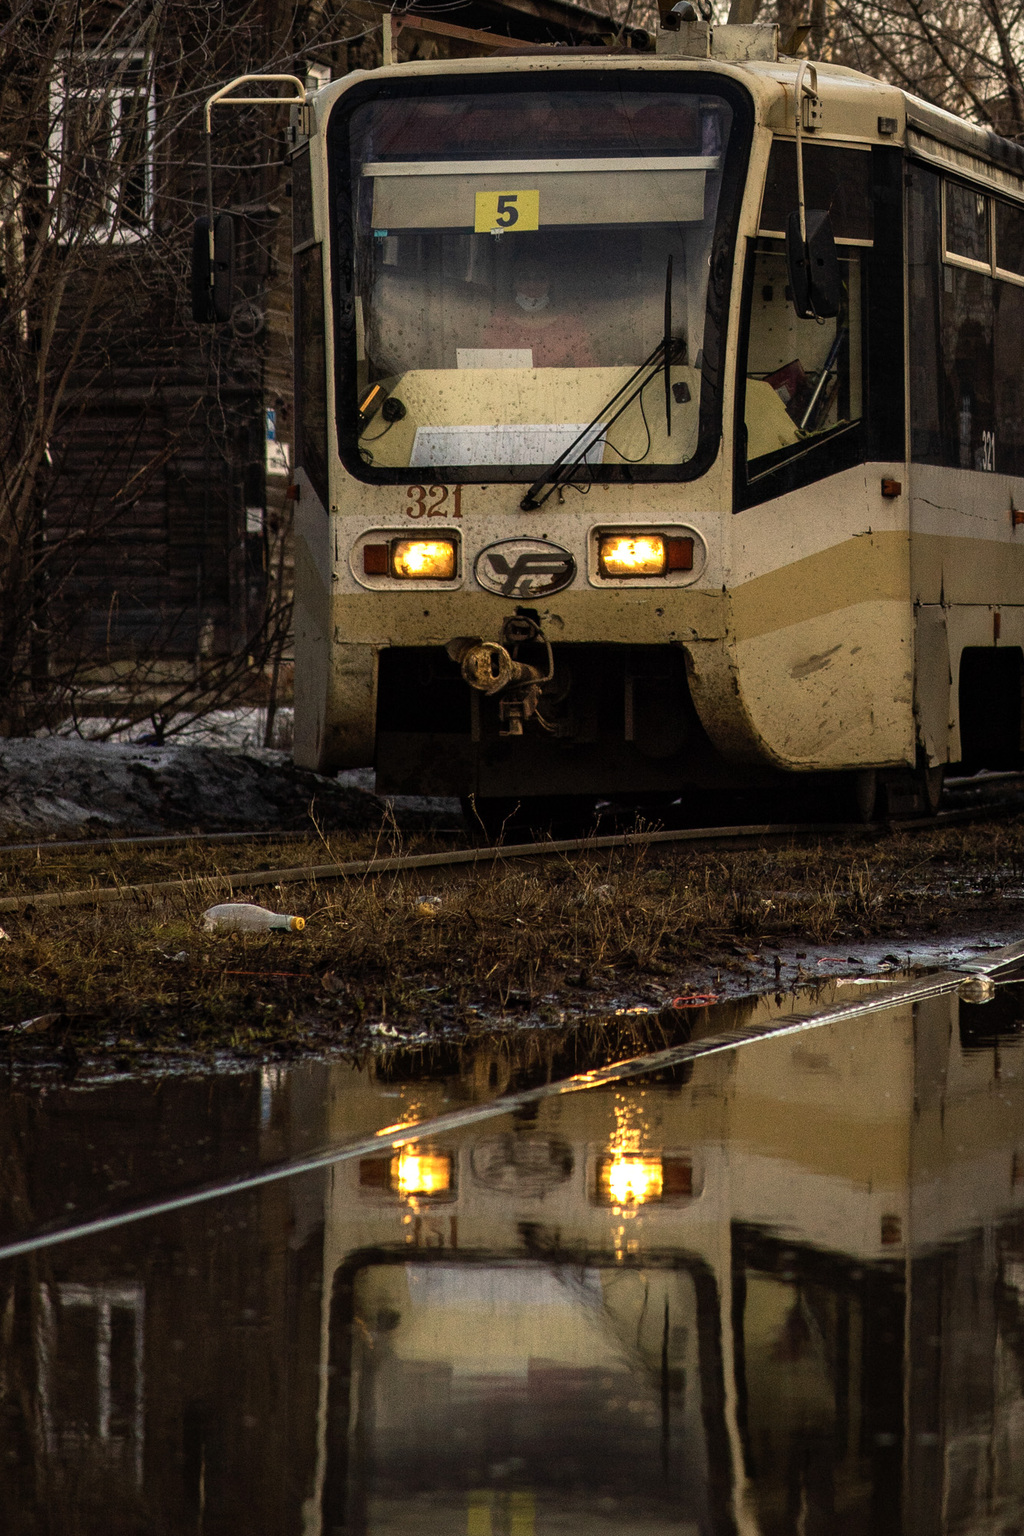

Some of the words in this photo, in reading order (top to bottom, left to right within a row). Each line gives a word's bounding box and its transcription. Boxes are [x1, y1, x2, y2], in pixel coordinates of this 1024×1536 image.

[496, 195, 519, 227] 5
[982, 429, 995, 471] 321
[406, 484, 463, 519] 321
